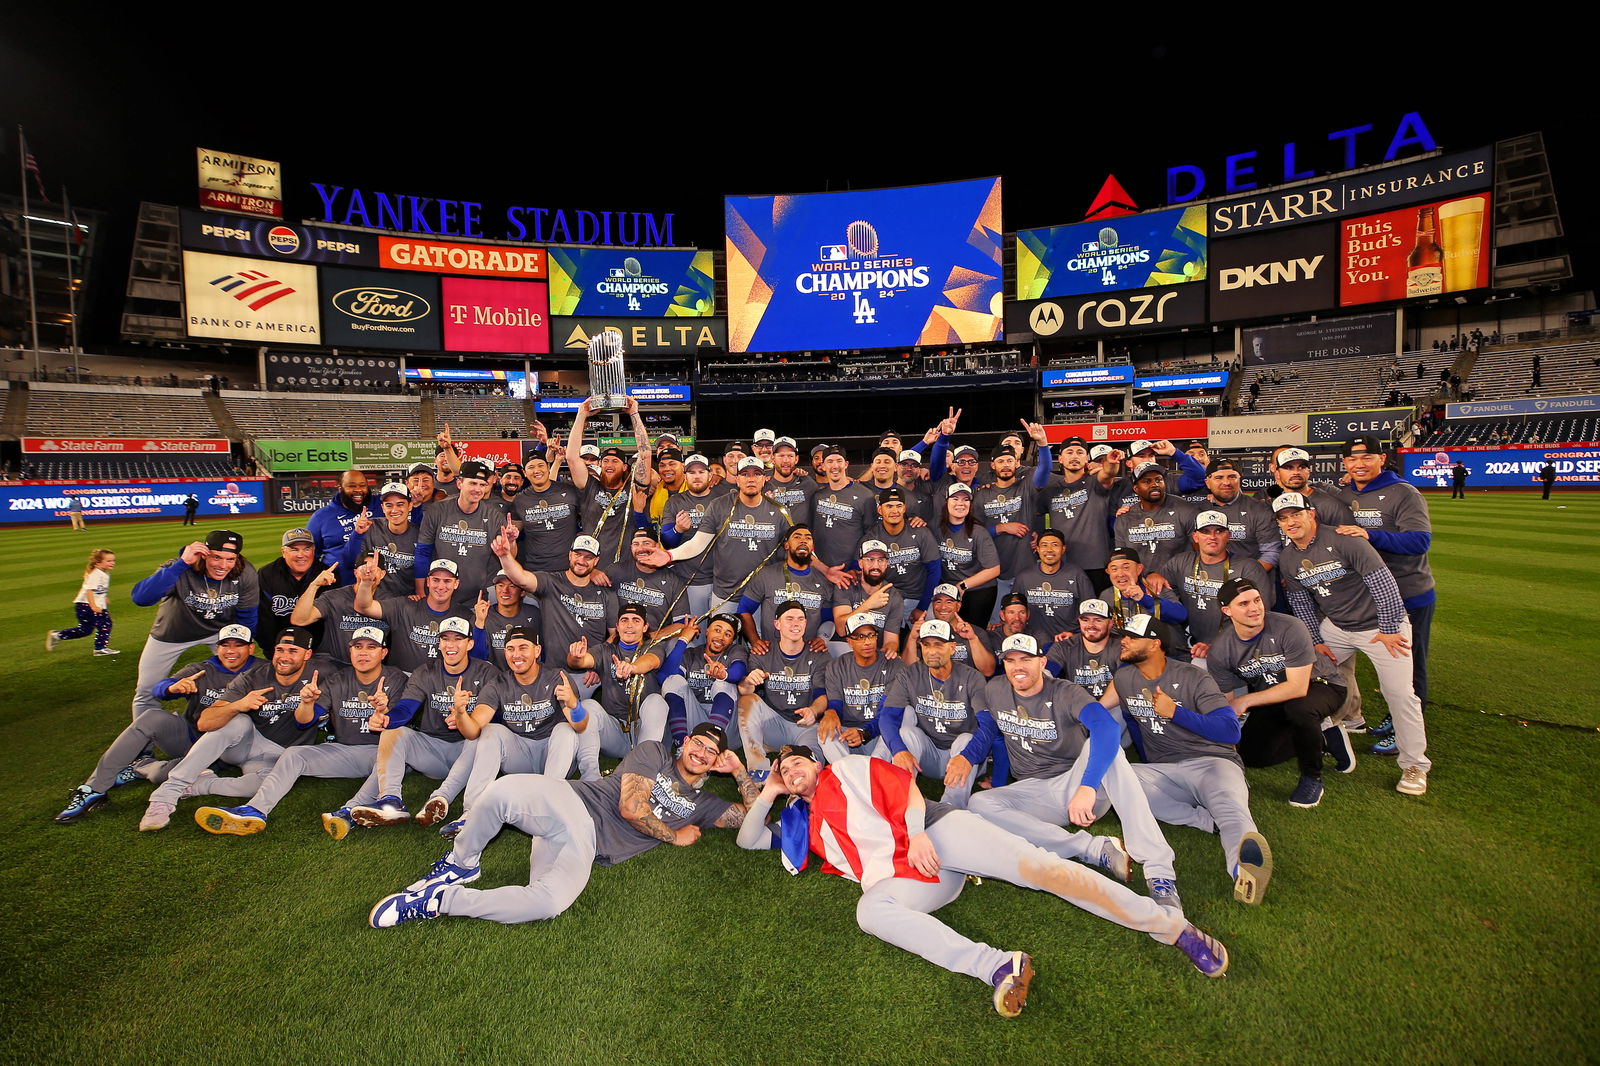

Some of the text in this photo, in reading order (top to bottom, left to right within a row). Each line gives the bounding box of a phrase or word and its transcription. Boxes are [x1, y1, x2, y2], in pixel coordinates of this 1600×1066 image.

[1167, 111, 1437, 204] DELTA
[202, 155, 276, 176] ARMITRON
[208, 191, 275, 209] ARMITRON
[1213, 160, 1486, 233] STARR INSURANCE
[310, 182, 676, 248] YANKEE STADIUM
[202, 224, 250, 241] PEPSI
[1346, 219, 1392, 238] This
[270, 235, 298, 244] PEPSI
[316, 240, 360, 253] PEPSI
[1347, 233, 1402, 254] Bud's
[390, 244, 539, 273] GATORADE
[1076, 246, 1139, 259] WORLD SERIES
[811, 258, 913, 272] WORLD SERIES
[1067, 250, 1150, 271] CHAMPIONS
[1347, 255, 1380, 269] For
[795, 266, 930, 294] CHAMPIONS
[1101, 267, 1118, 286] LA
[1219, 255, 1324, 291] DKNY
[1346, 270, 1390, 285] You.
[596, 282, 668, 295] CHAMPIONS
[879, 290, 895, 298] 24
[351, 291, 413, 318] Ford
[627, 293, 642, 311] LA
[853, 291, 877, 324] LA
[450, 305, 541, 327] T Mobile
[1077, 291, 1178, 330] razr
[190, 316, 317, 334] BANK OF AMERICA
[351, 322, 415, 333] BuyFordNow.com
[1307, 346, 1361, 358] THE BOSS
[1550, 400, 1596, 408] FANDUEL
[1111, 427, 1147, 436] TOYOTA
[1211, 428, 1232, 436] BANK
[1246, 427, 1283, 435] AMERICA
[307, 449, 349, 463] Eats
[1412, 467, 1472, 477] CHAMPI
[1485, 462, 1520, 474] 2024
[1521, 461, 1574, 474] WOLD
[1242, 478, 1278, 489] StubHu
[62, 487, 152, 495] CONGRATULATIONS
[9, 494, 198, 510] 2024 WOD SERIES CHAMPIO
[283, 498, 331, 511] StubHu
[549, 504, 569, 512] SERIES
[441, 526, 487, 538] WORLD SERIES
[729, 522, 751, 530] WORLD
[1128, 524, 1175, 535] WORLD SERIES
[458, 543, 468, 556] LA
[748, 538, 758, 551] LA
[620, 583, 665, 598] WORLD SERIES
[1045, 604, 1054, 617] LA
[428, 644, 438, 658] LA
[1259, 655, 1285, 667] SERIES
[769, 674, 792, 682] WORLD
[787, 692, 797, 705] LA
[844, 688, 868, 696] WORLD
[504, 700, 551, 712] WORLD SERIES
[918, 698, 965, 710] WORLD SERIES
[864, 705, 874, 720] LA
[916, 706, 967, 719] CHAMPIONS
[935, 718, 947, 733] LA
[997, 711, 1055, 729] WORLD SERIES
[998, 720, 1057, 740] CHAMPIONS
[1020, 736, 1034, 753] LA
[673, 796, 697, 811] SERIES
